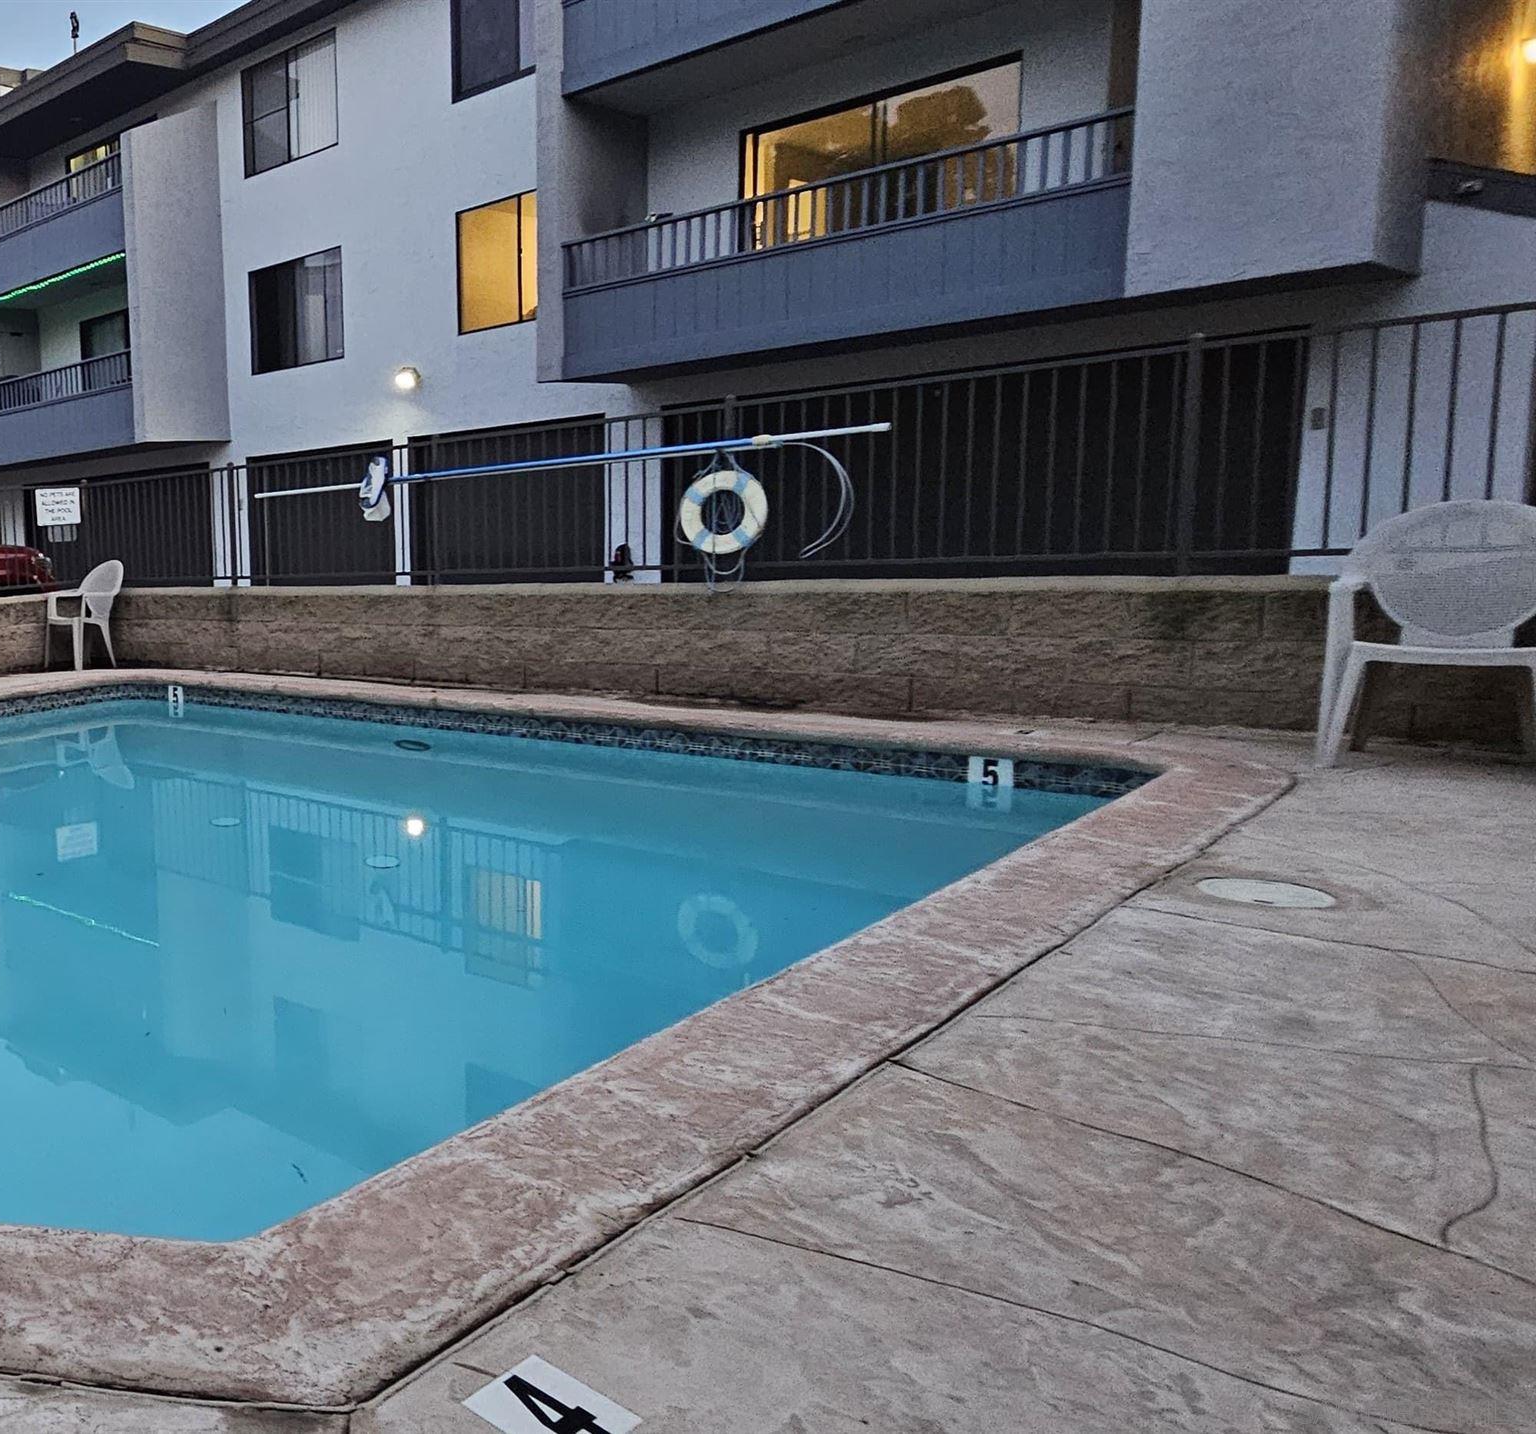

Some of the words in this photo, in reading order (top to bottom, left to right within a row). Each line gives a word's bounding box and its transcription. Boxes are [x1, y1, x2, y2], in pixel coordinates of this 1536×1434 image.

[173, 687, 179, 703] 5
[982, 759, 999, 786] 5
[503, 1374, 612, 1434] 4
